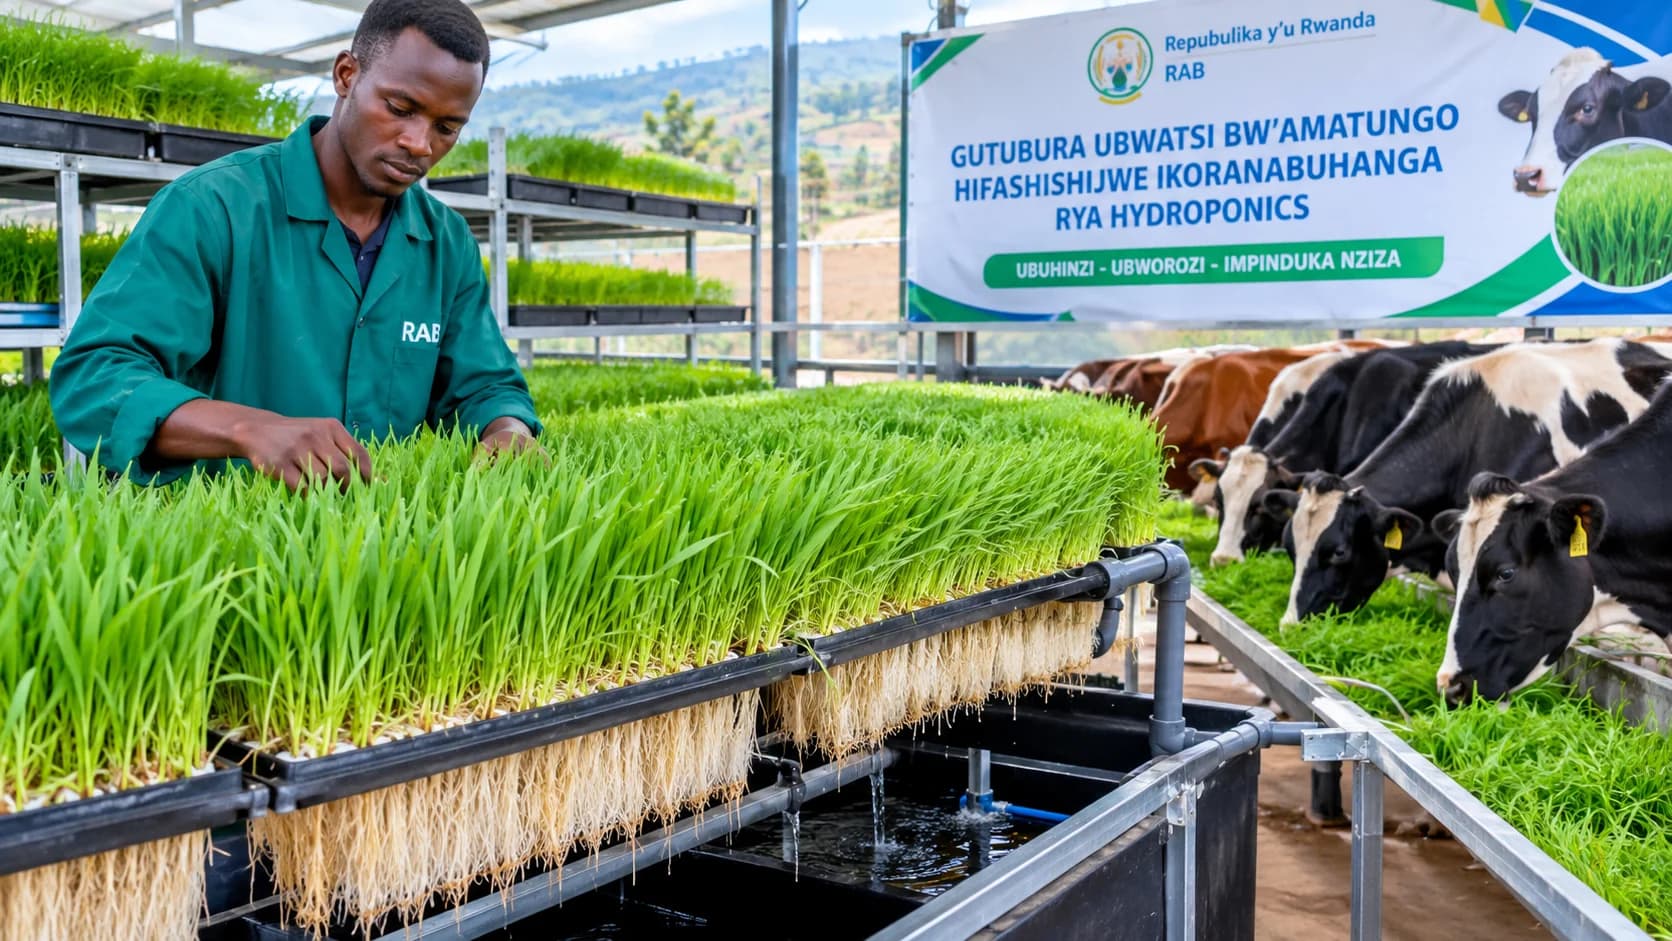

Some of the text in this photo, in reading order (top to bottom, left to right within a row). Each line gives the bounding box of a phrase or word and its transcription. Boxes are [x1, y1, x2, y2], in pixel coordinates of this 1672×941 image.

[1165, 26, 1263, 53] Repubulika
[1300, 11, 1376, 35] Rwanda
[1165, 61, 1205, 82] RAB
[950, 134, 1086, 168] GUTUBURA
[1094, 123, 1214, 157] UBWATSI
[954, 146, 1443, 201] HIFASHISHIJWE IKORANABUHANGA
[1055, 193, 1309, 230] RYA HYDROPONICS
[1016, 260, 1094, 279] UBUHINZI
[1111, 257, 1205, 275] UBWOROZI
[1224, 252, 1335, 273] IMPINDUKA
[1340, 249, 1401, 269] NZIZA
[402, 321, 440, 342] RAB
